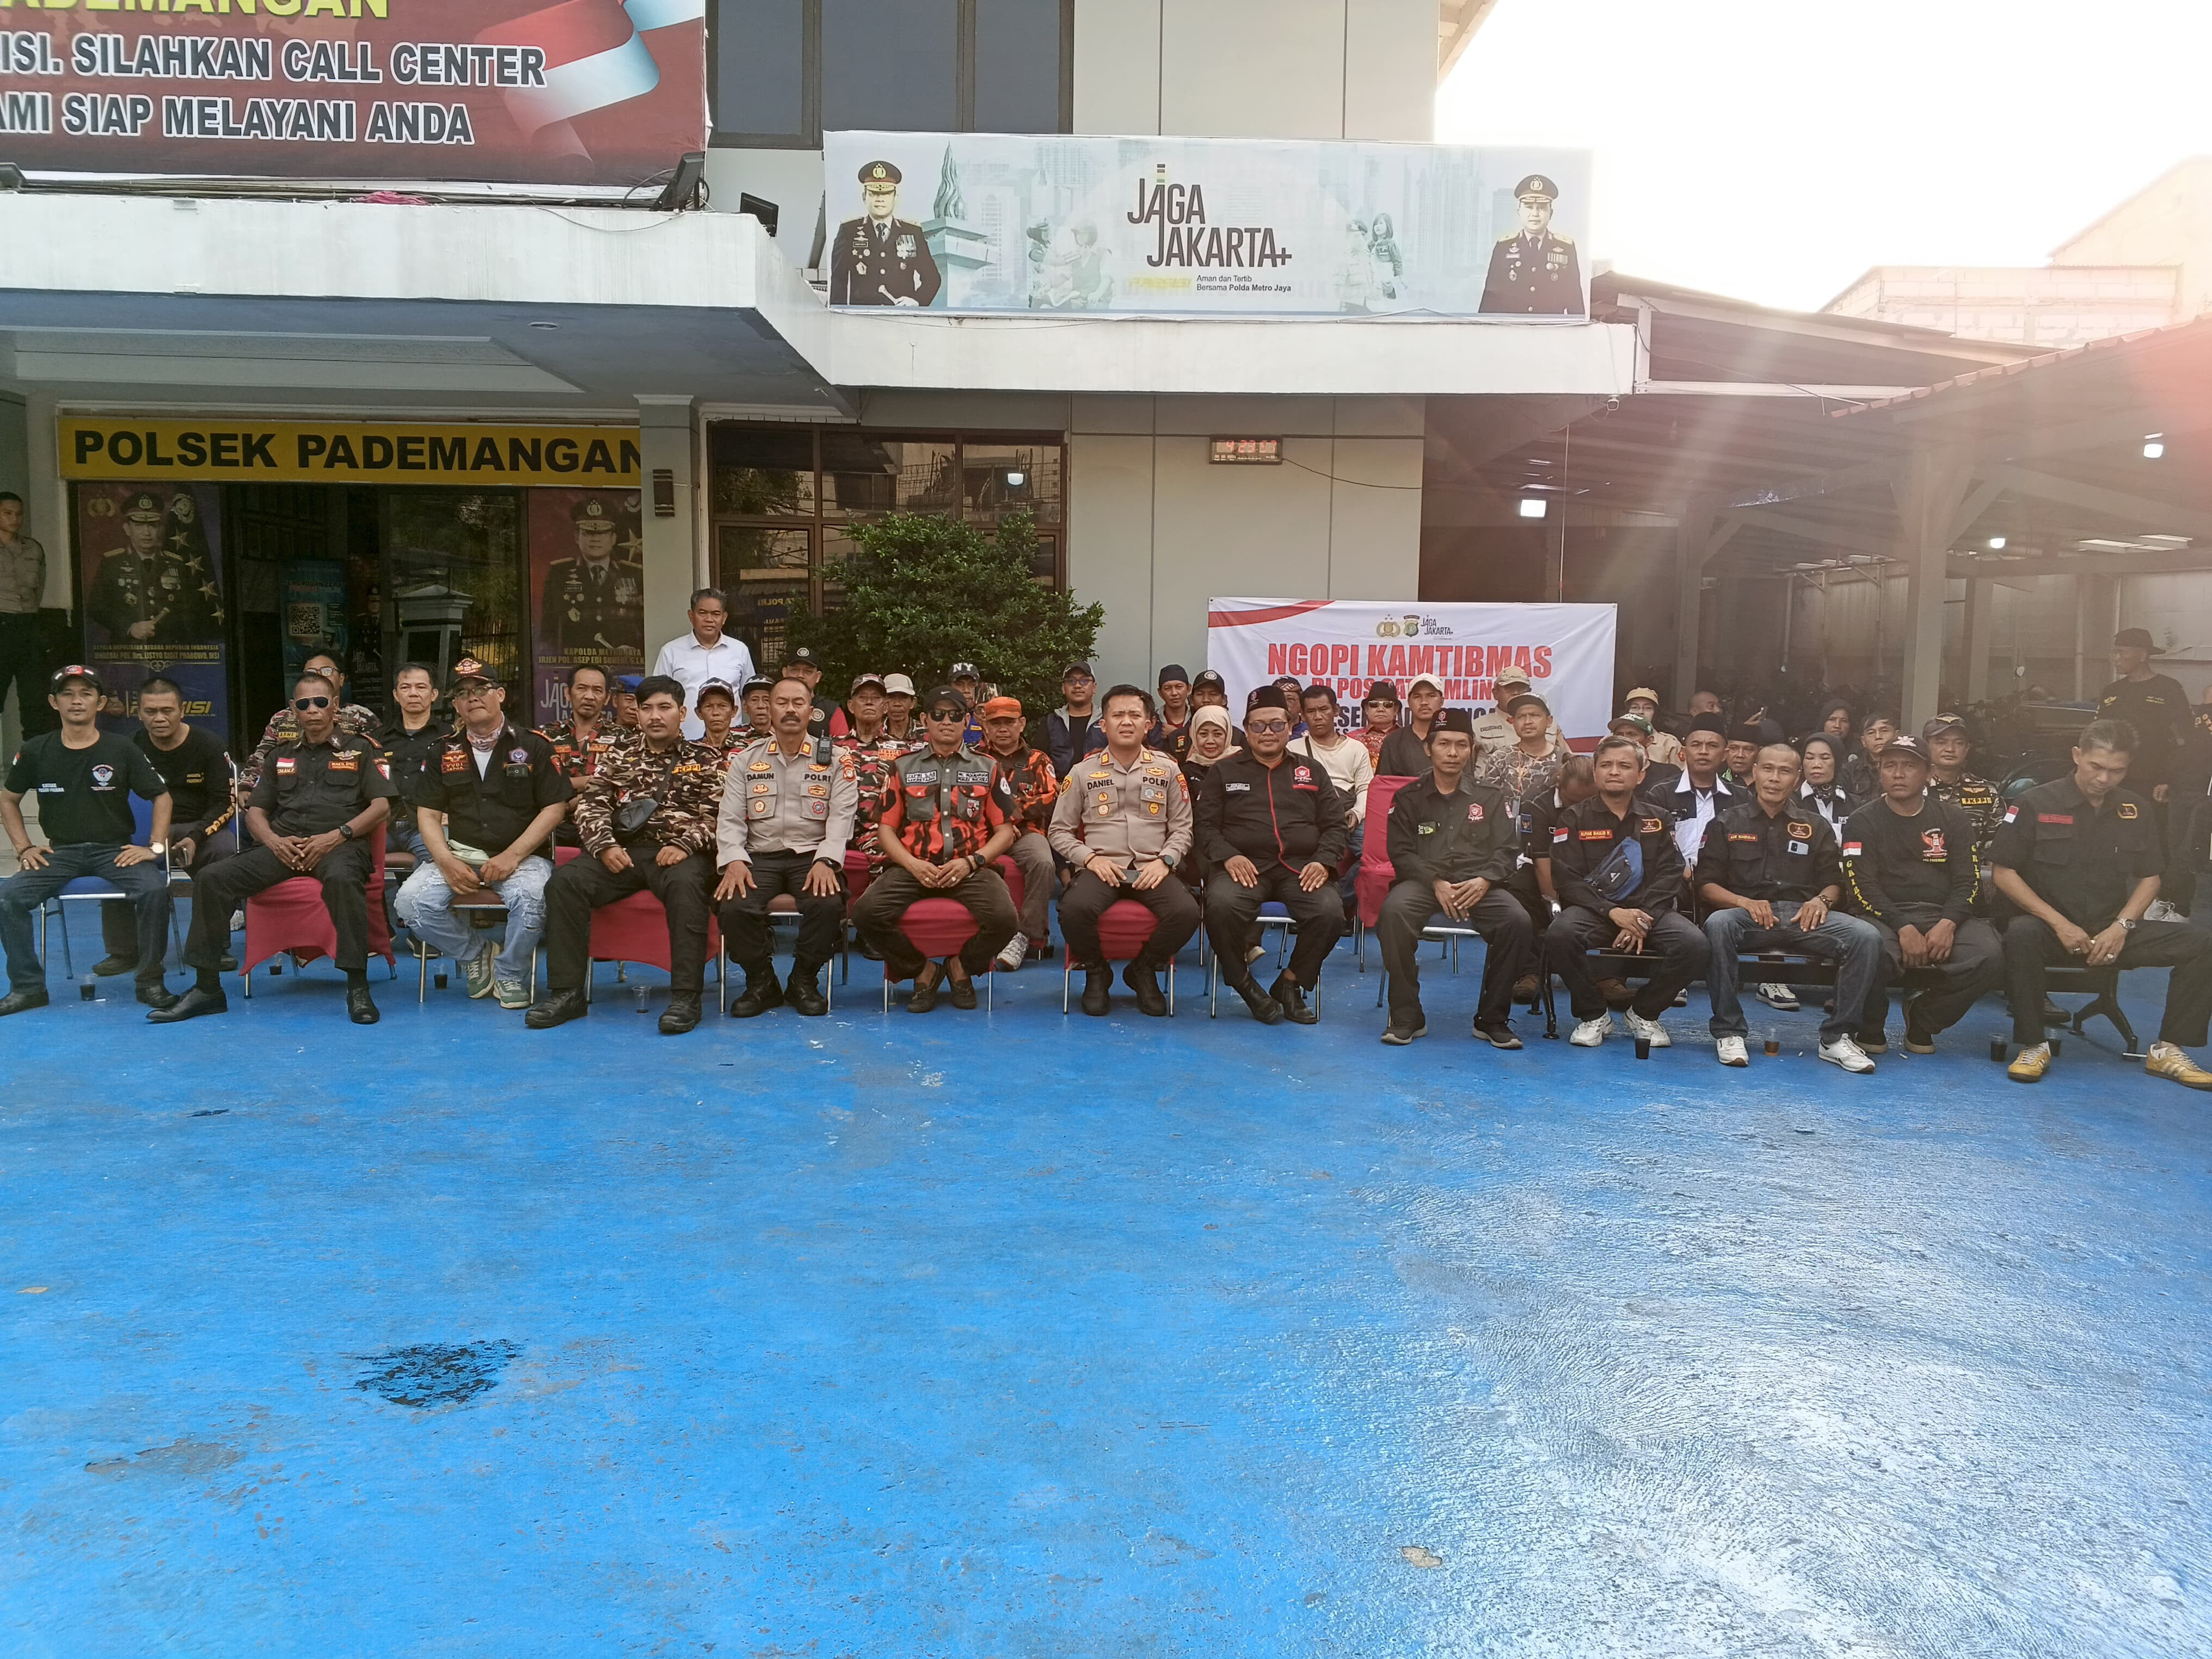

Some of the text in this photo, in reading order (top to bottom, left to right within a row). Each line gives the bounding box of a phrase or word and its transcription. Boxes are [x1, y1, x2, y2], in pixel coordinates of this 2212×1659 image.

[71, 33, 272, 81] SILAHKAN
[281, 38, 383, 85] CALL
[390, 44, 546, 88] CENTER
[62, 92, 153, 137] SIAP
[162, 96, 357, 142] MELAYANI
[365, 101, 475, 146] ANDA
[1127, 178, 1206, 224] JAGA
[1274, 285, 1292, 293] Jaya
[75, 430, 640, 473] POLSEK PADEMANGAN
[953, 663, 973, 671] NY
[1268, 643, 1552, 679] NGOPI KAMTIBMAS
[804, 774, 831, 782] POLRI
[1087, 779, 1115, 790] DANIEL
[1142, 777, 1169, 788] POLRI
